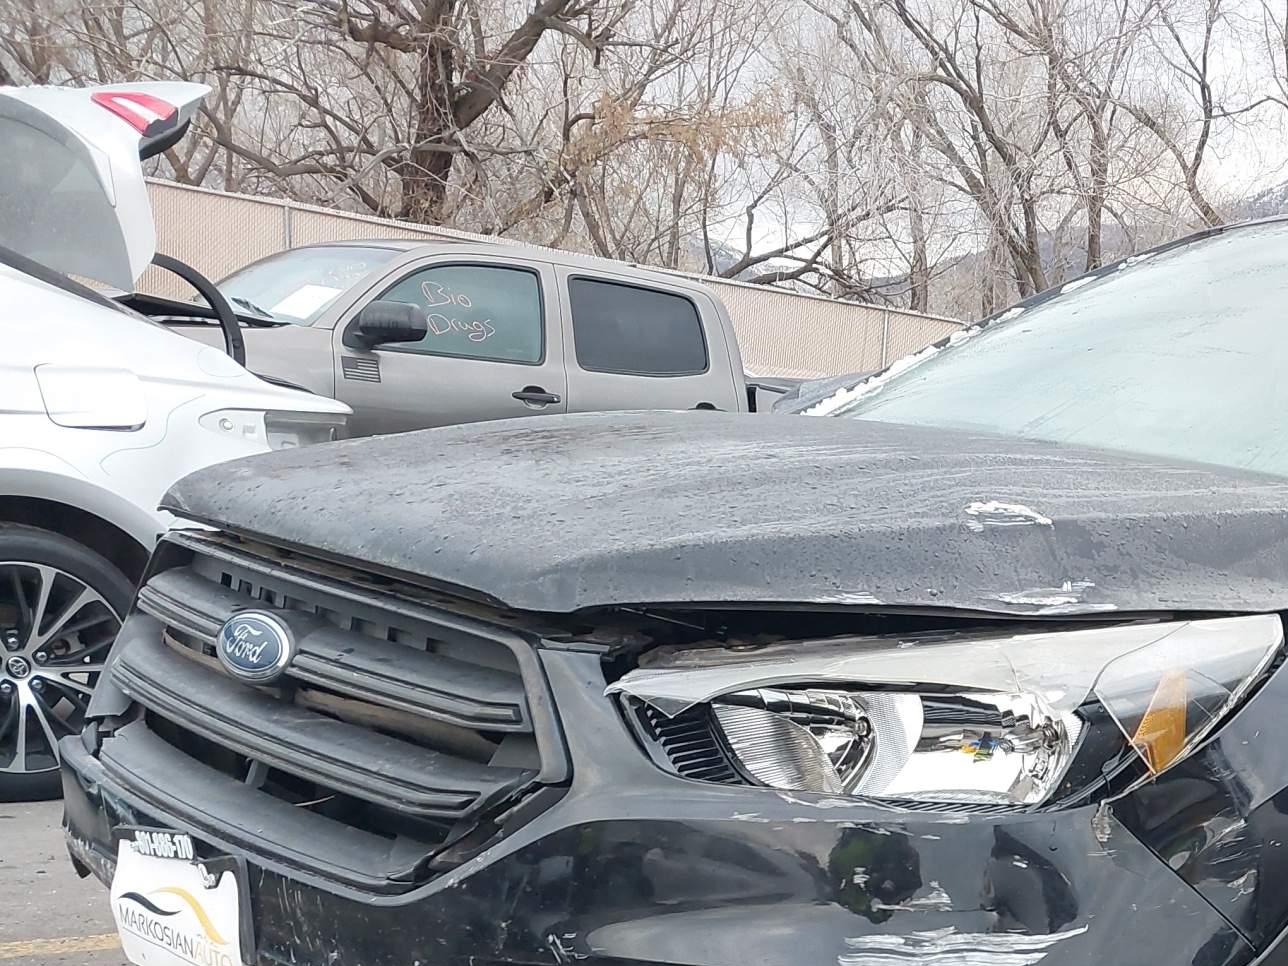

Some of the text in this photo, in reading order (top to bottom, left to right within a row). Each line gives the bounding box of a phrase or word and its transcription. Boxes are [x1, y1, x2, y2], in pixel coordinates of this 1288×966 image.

[421, 281, 472, 307] Bio
[427, 313, 496, 341] Drugs
[226, 623, 268, 664] Ford
